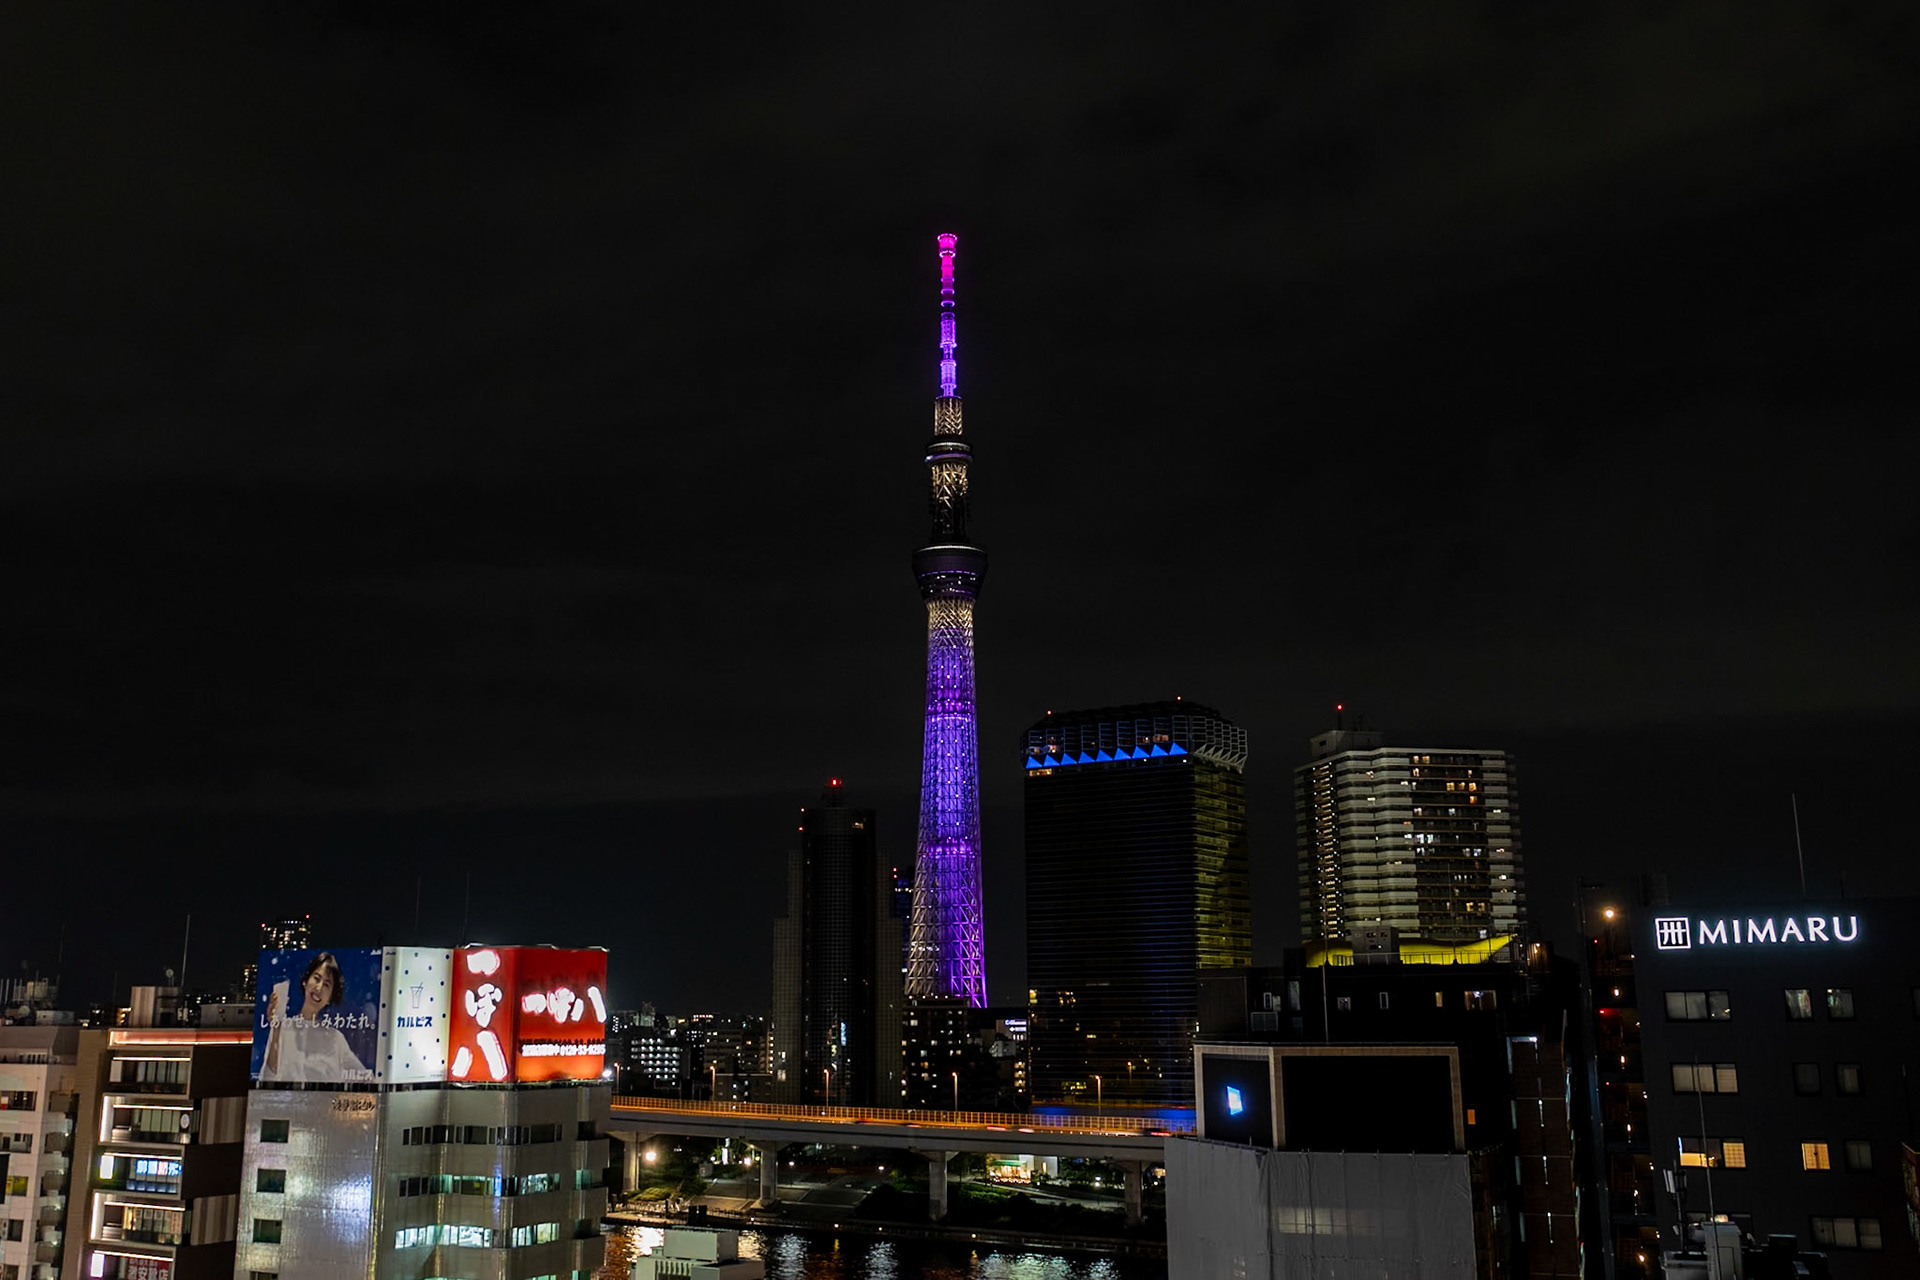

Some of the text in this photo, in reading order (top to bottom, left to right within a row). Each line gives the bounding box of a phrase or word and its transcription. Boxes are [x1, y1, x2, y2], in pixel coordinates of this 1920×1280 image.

[1699, 916, 1858, 945] MIMARU
[397, 1016, 433, 1028] カルピス
